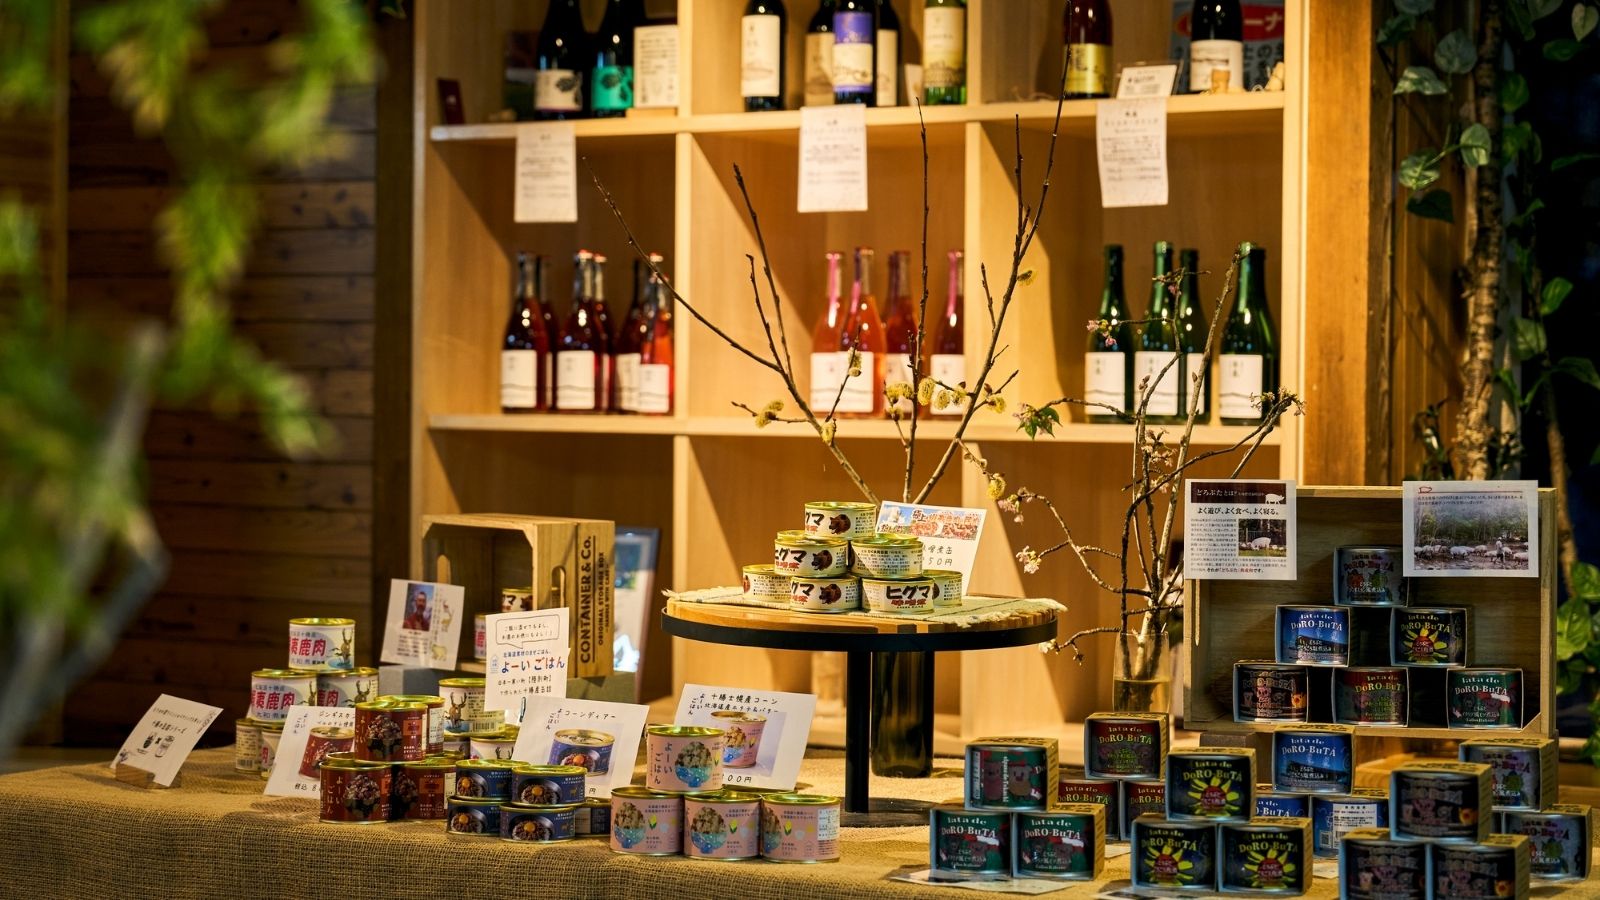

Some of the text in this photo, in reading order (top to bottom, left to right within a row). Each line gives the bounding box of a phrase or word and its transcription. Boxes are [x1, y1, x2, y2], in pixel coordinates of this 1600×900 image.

[886, 585, 931, 599] ヒグマ
[580, 536, 592, 664] CONTAINER & Co.
[972, 817, 987, 825] de
